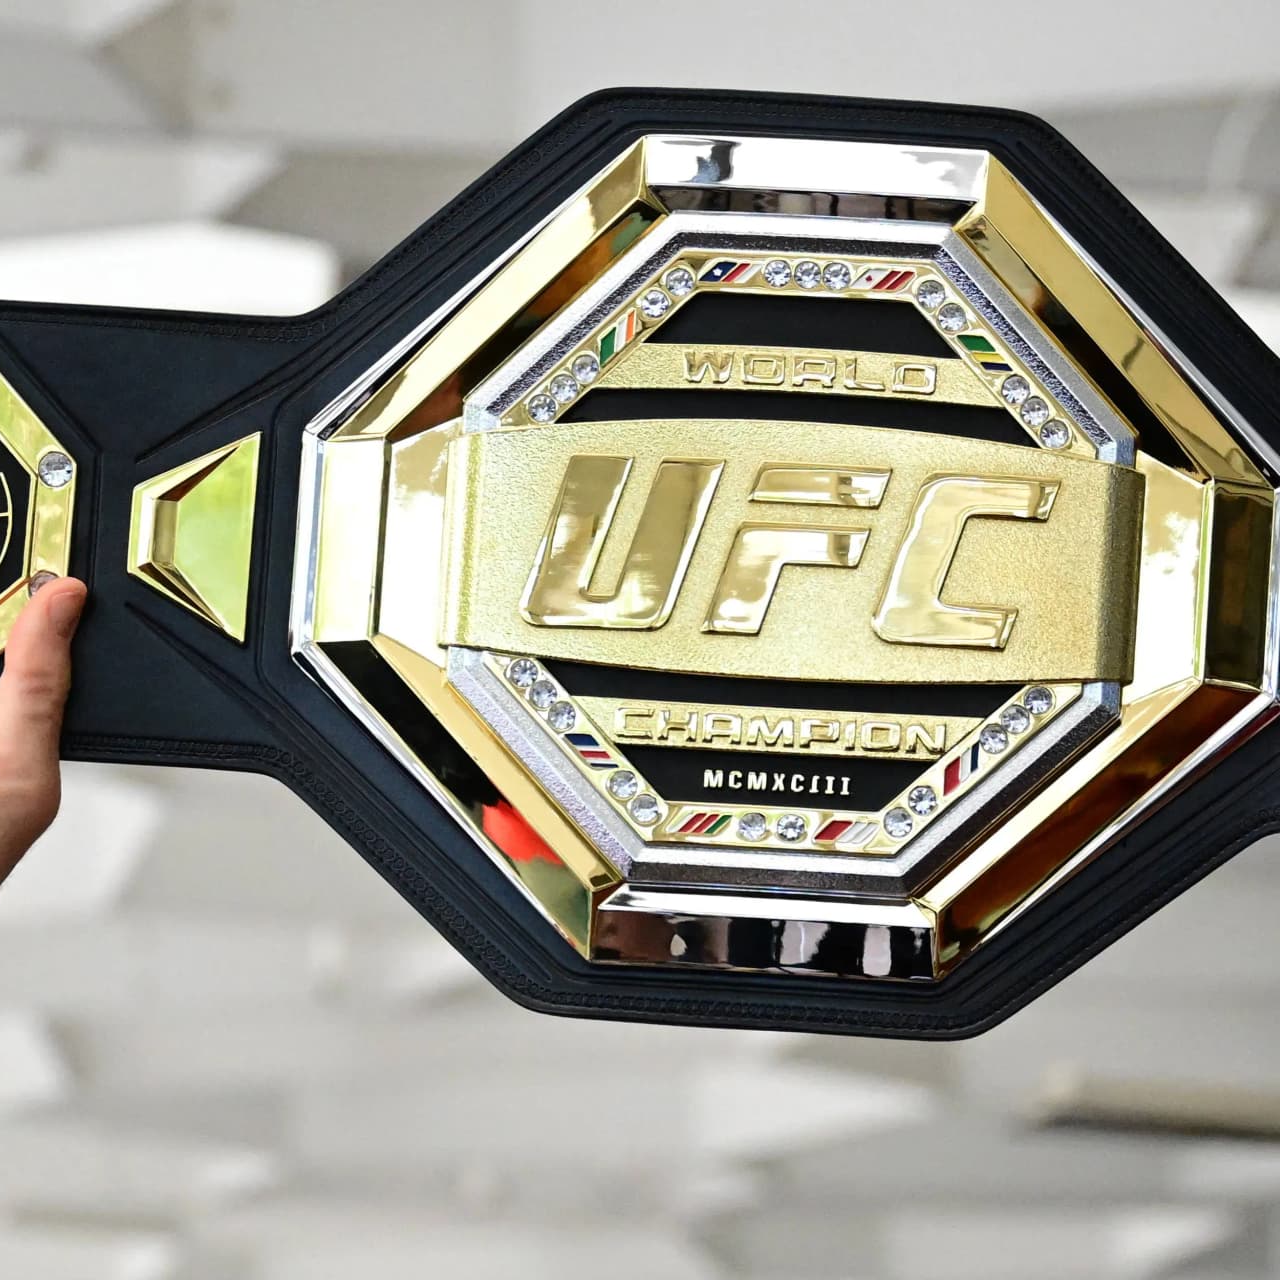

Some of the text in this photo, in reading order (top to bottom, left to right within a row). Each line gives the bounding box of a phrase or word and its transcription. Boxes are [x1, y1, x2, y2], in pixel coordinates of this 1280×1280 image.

[683, 350, 937, 395] WORLD
[520, 454, 1063, 650] UFC
[614, 706, 948, 755] CHAMPION
[703, 769, 851, 796] MCMXCIII
